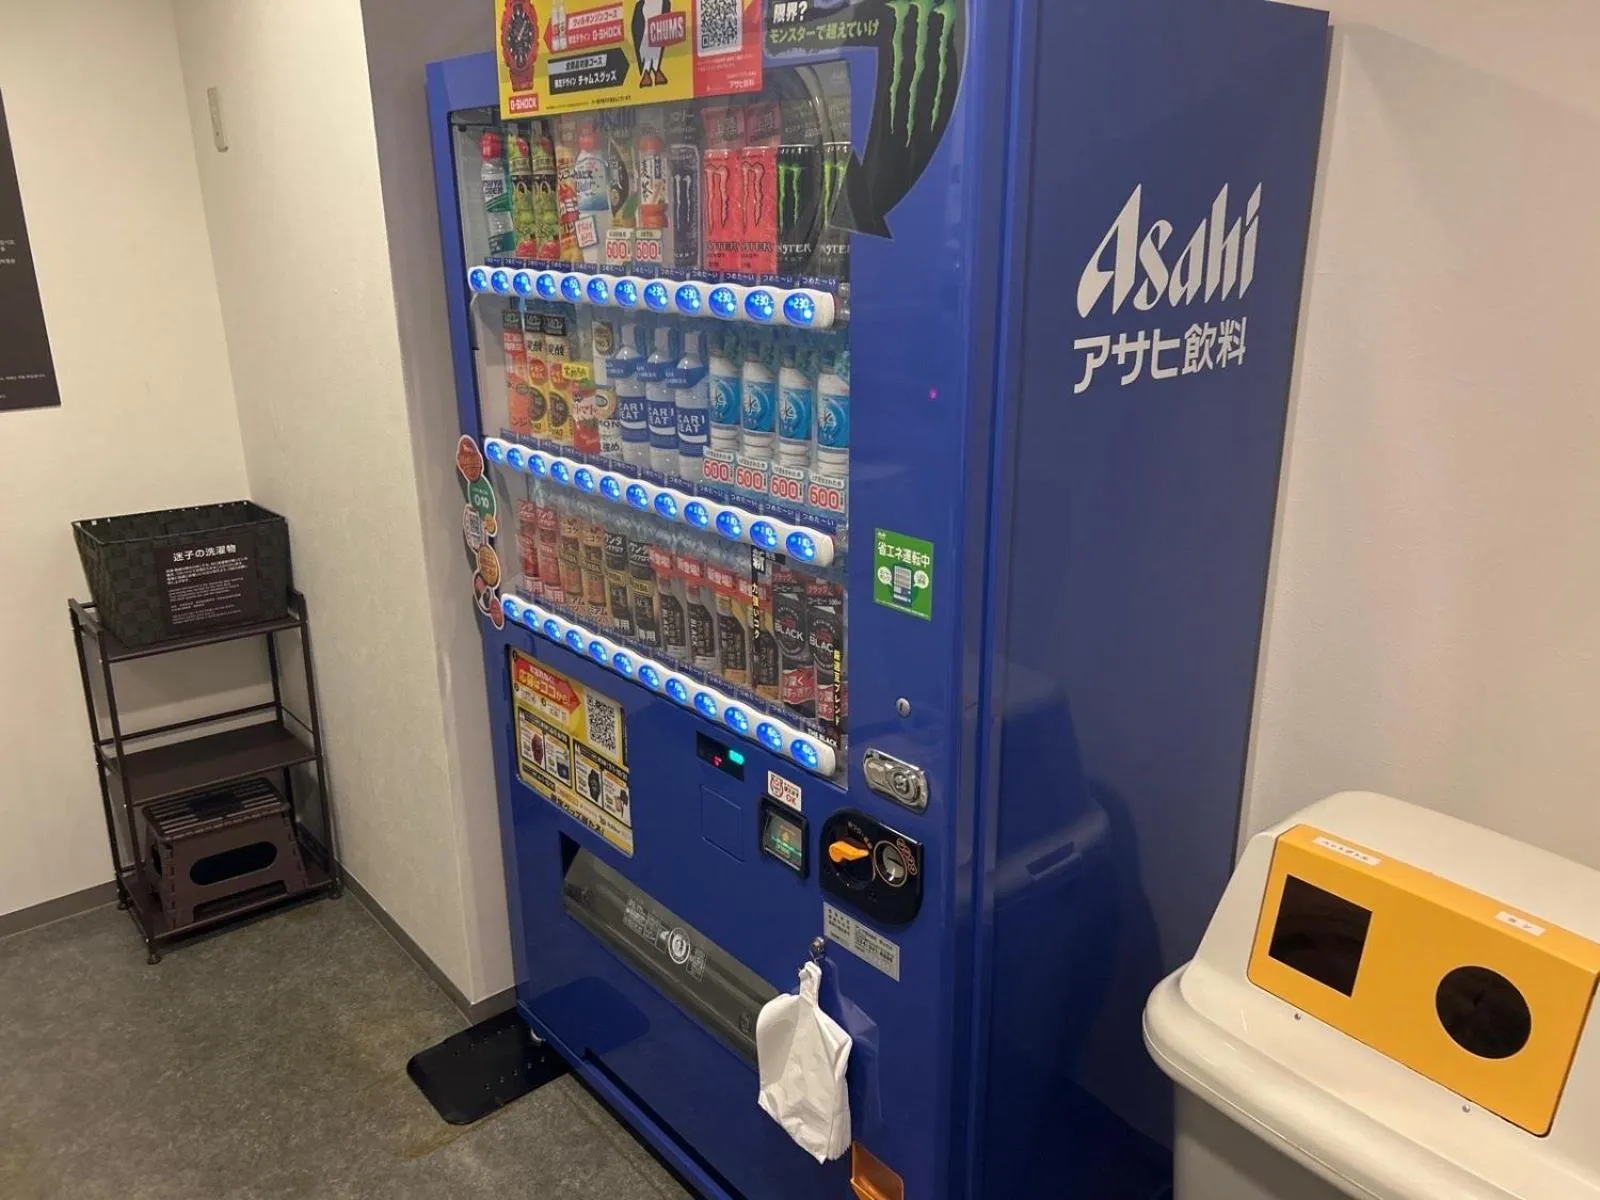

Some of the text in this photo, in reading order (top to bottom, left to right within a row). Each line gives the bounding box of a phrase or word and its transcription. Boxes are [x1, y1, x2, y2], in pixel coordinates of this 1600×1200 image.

[649, 16, 684, 43] CHUMS
[770, 18, 880, 43] モンスターで超えていけ
[1076, 181, 1263, 319] Asahi
[1073, 316, 1247, 395] アサヒ飲料
[704, 460, 729, 481] 600
[737, 467, 762, 491] 600
[771, 475, 799, 500] 600
[810, 485, 839, 510] 600
[173, 544, 236, 562] 迷子の洗濯物
[774, 619, 805, 642] BLACK
[809, 632, 835, 653] BLAC
